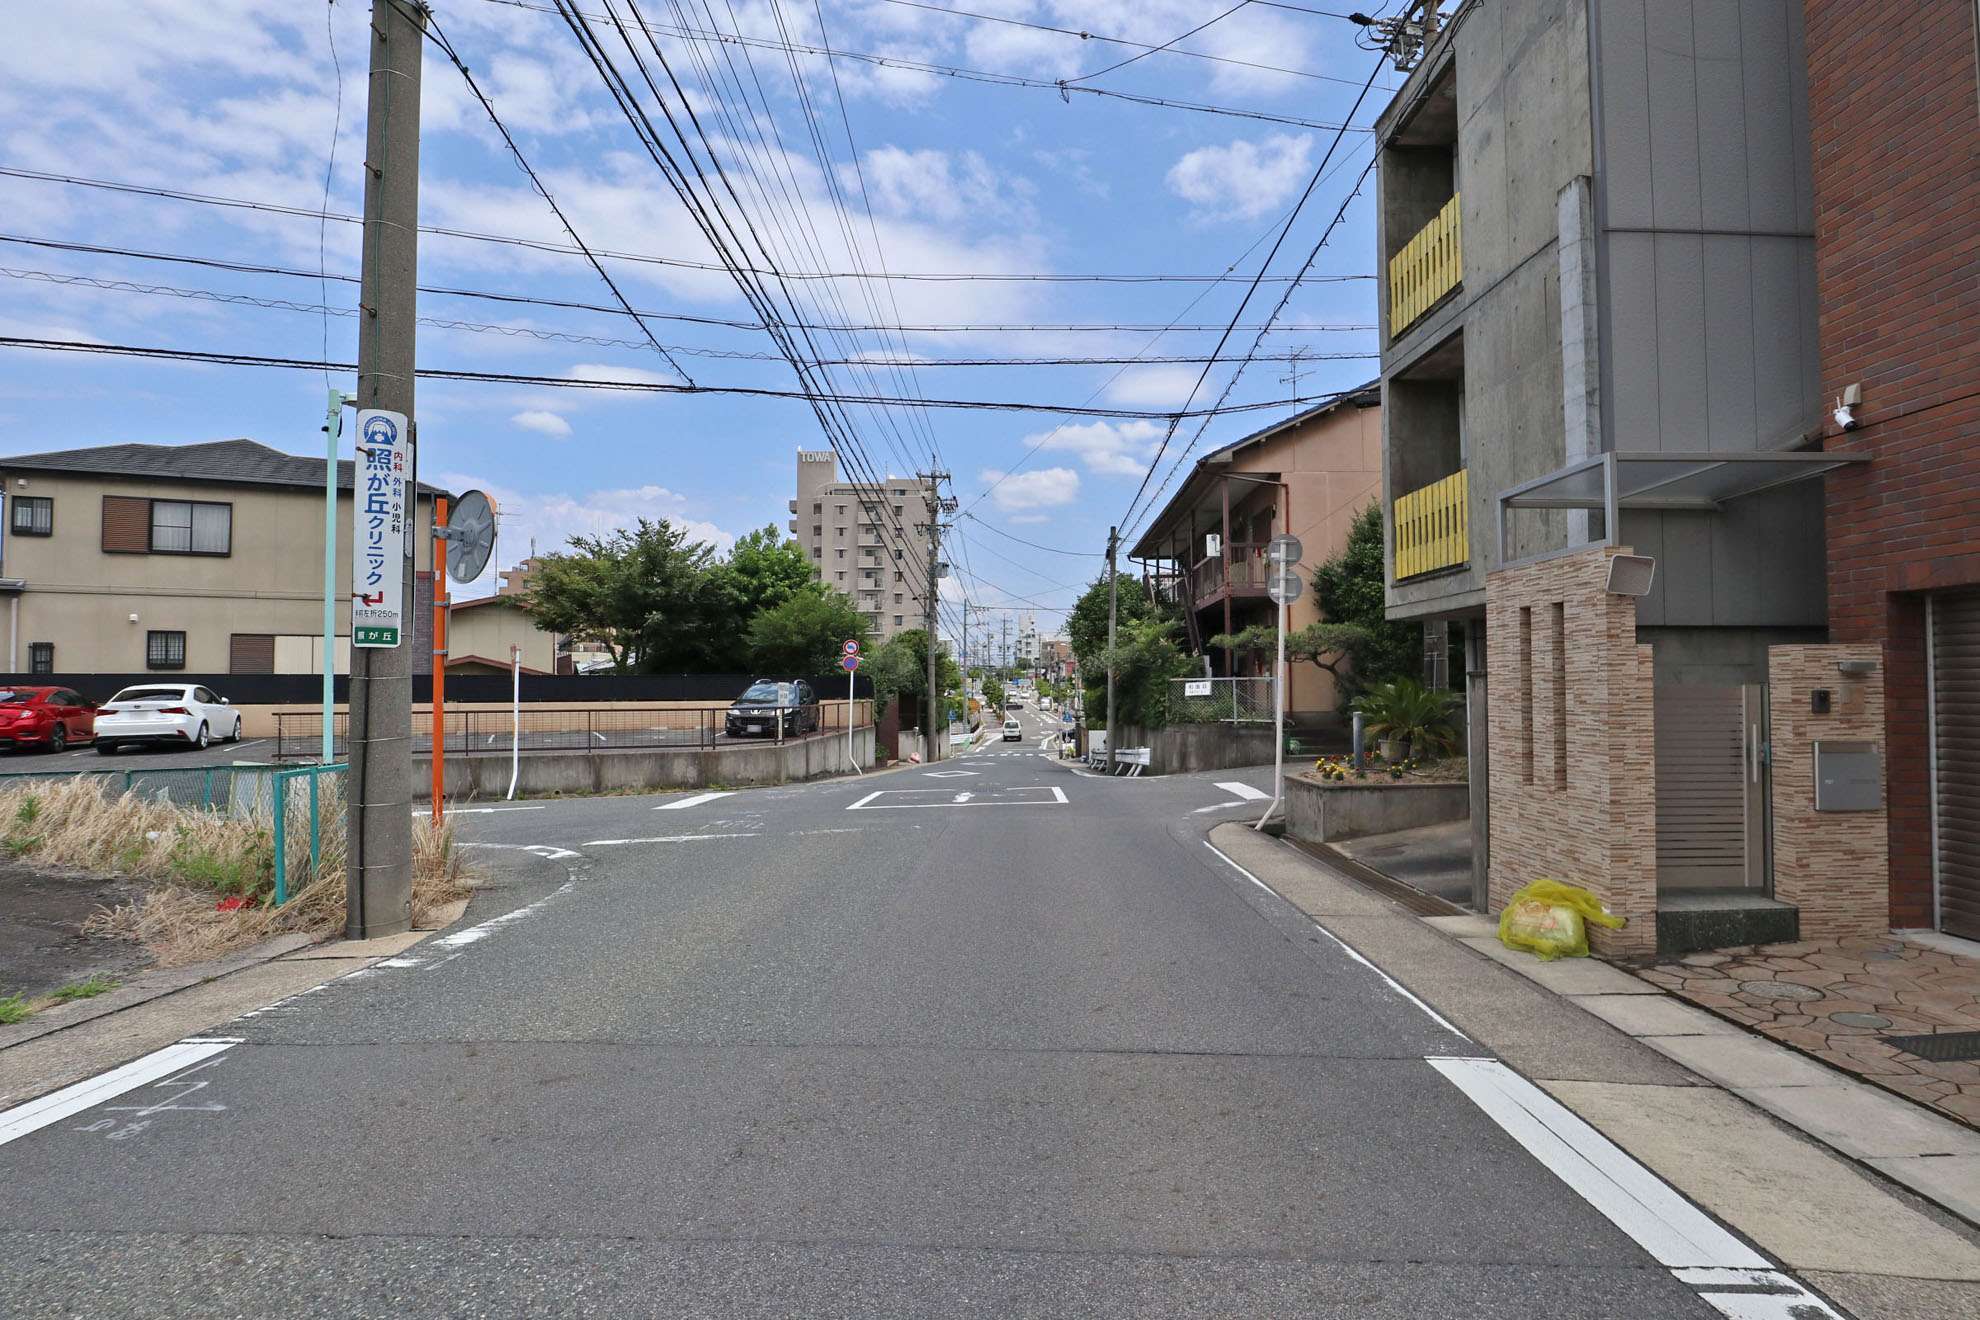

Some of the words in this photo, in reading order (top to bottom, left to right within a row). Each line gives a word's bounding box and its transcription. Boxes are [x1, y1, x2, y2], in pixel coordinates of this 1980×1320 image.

[393, 451, 403, 473] 内科
[801, 453, 832, 462] TOWA
[392, 476, 402, 497] 外科
[364, 447, 392, 586] 照が丘クリニック
[390, 501, 402, 535] 小児科
